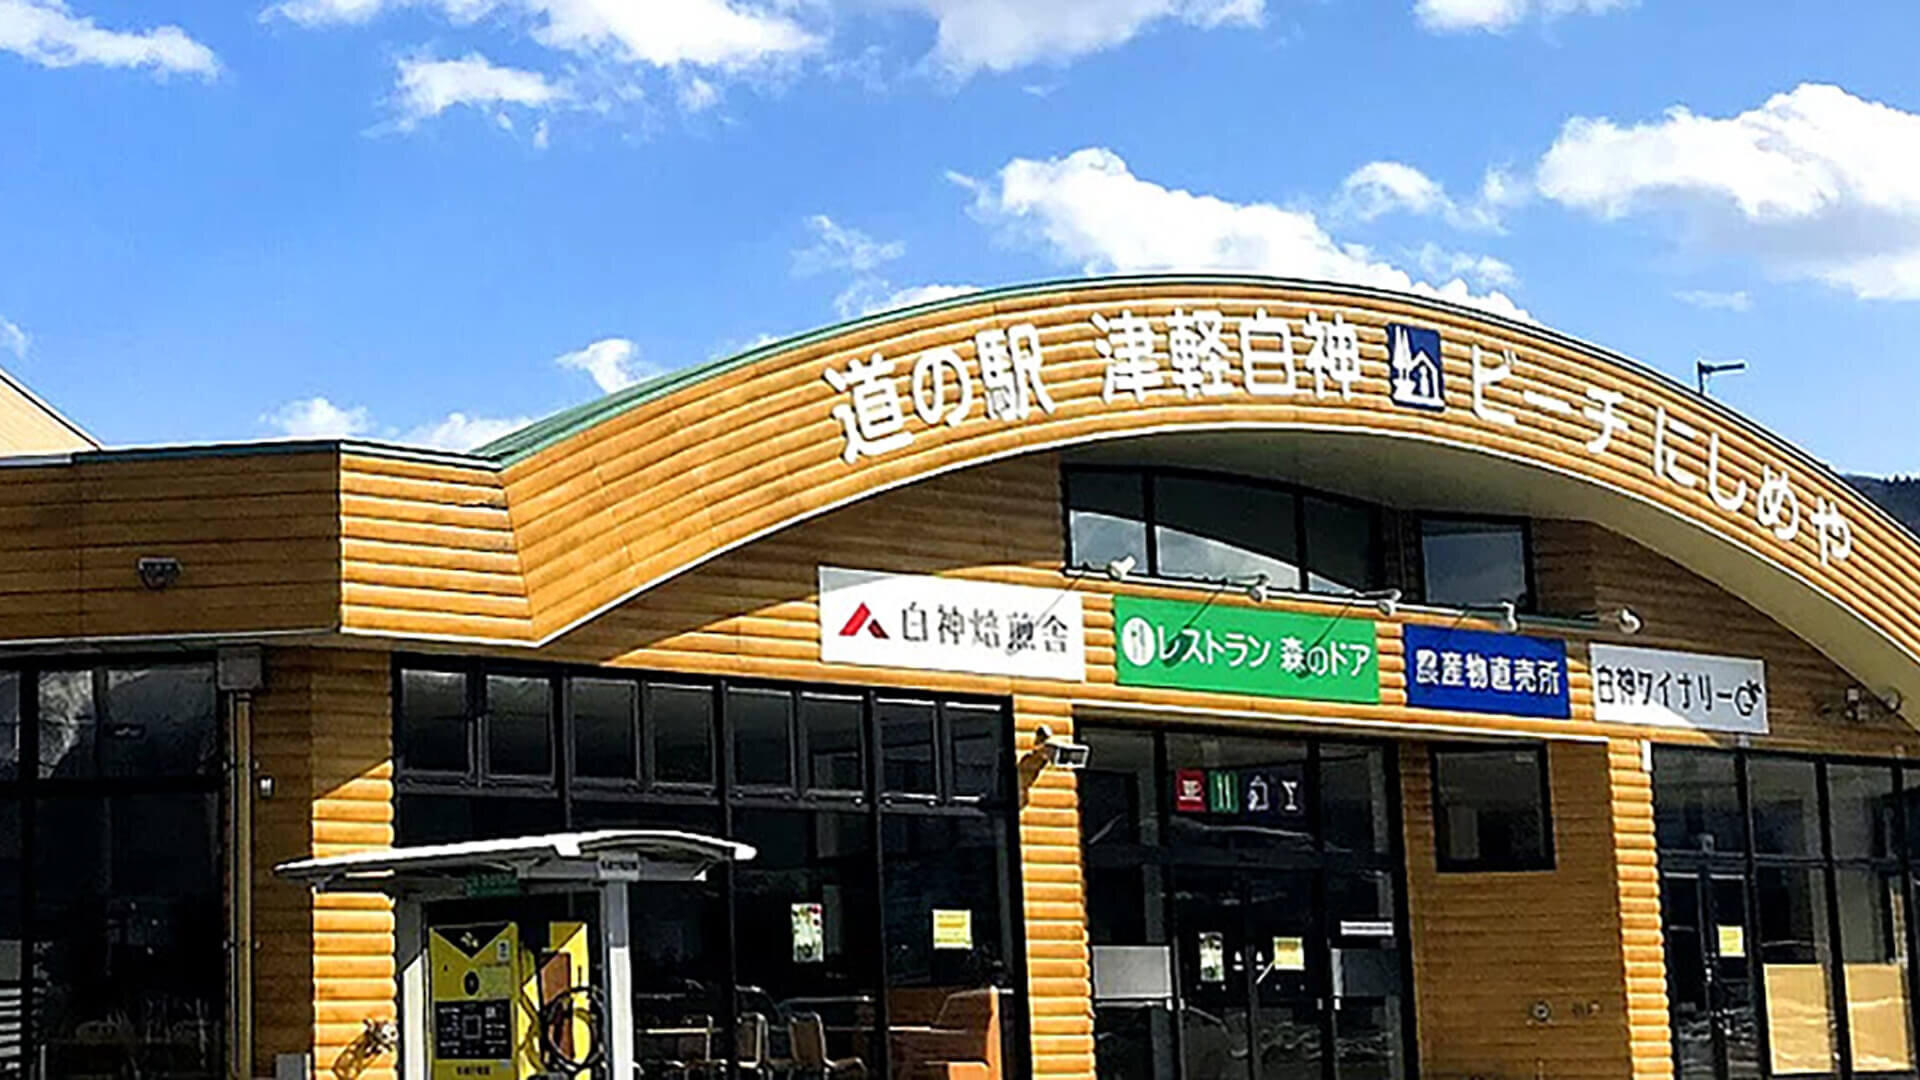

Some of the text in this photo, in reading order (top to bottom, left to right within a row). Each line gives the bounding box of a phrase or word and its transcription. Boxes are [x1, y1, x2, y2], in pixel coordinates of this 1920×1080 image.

[823, 323, 1057, 463] 道の駅
[1090, 307, 1363, 403] 津軽白神
[1157, 624, 1371, 677] レストラン 森のドア
[1596, 664, 1733, 712] 白神ワイナリー
